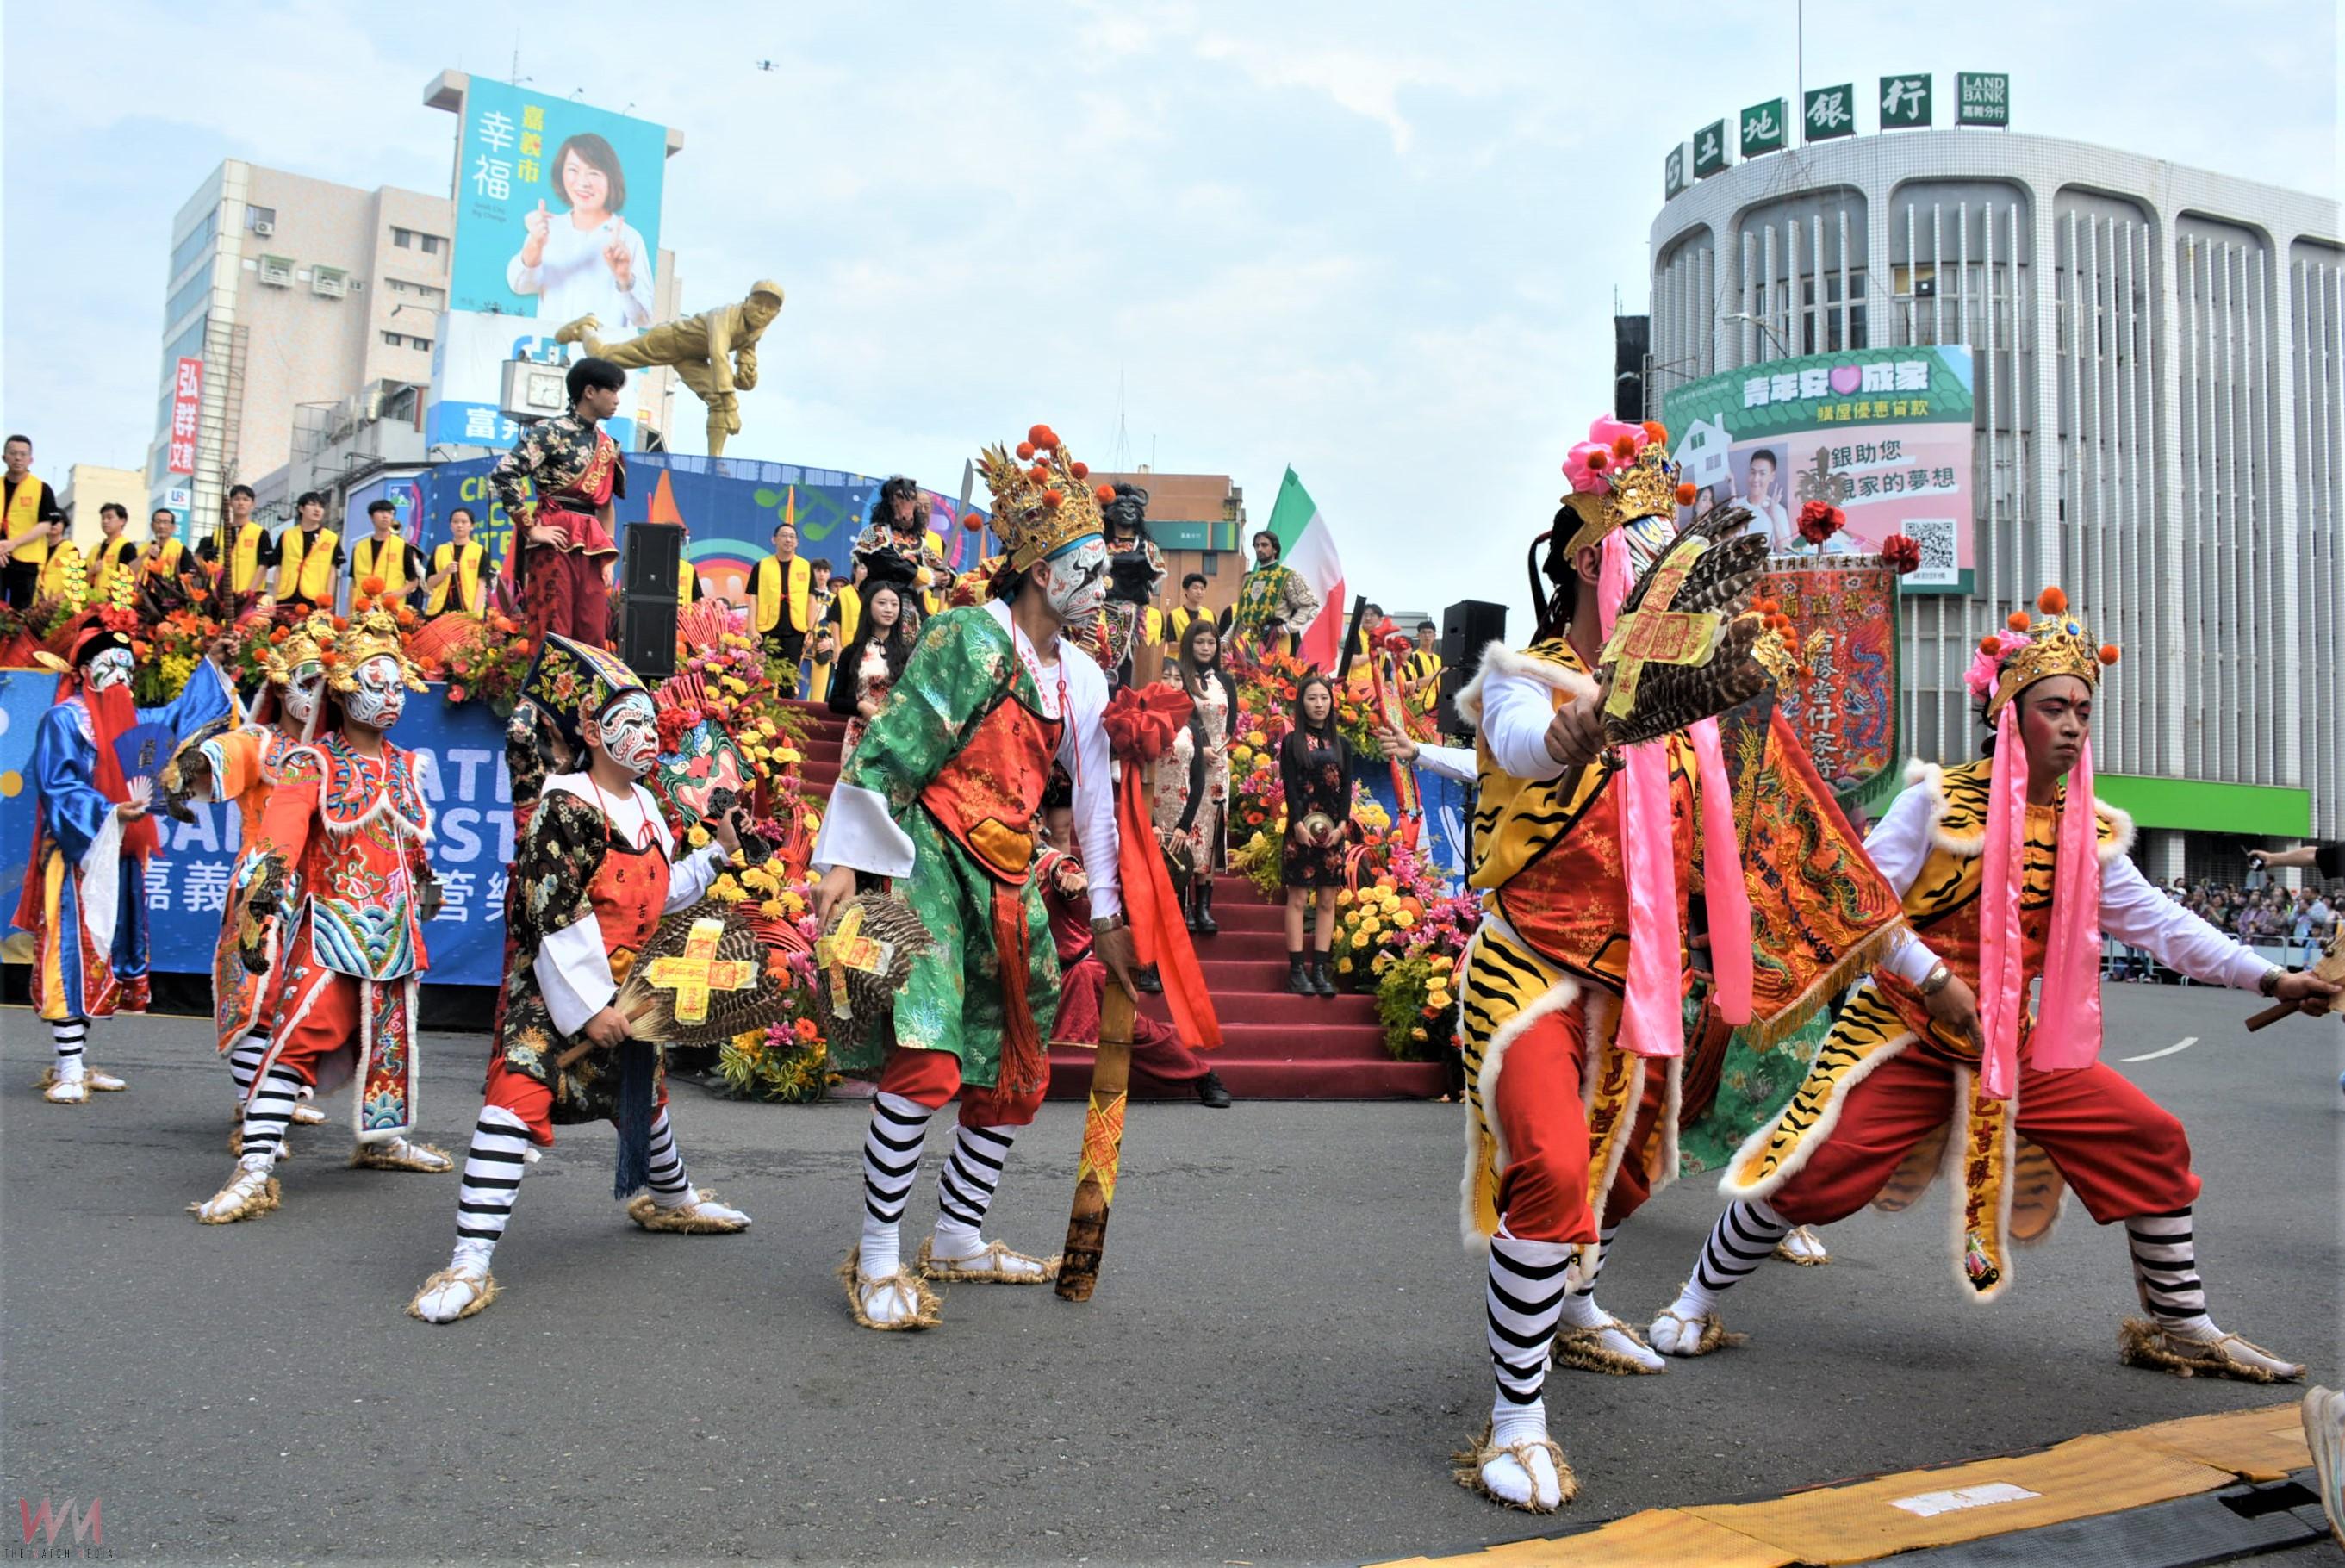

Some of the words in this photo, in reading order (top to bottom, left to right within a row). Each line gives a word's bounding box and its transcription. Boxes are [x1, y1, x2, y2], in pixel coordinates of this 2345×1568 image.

[1962, 76, 2006, 90] LAND
[1962, 89, 2006, 103] BANK
[518, 104, 545, 184] 嘉義市
[1696, 79, 1927, 166] 土地銀行
[472, 109, 516, 202] 幸福
[1816, 399, 1930, 423] 購屋優惠貸款
